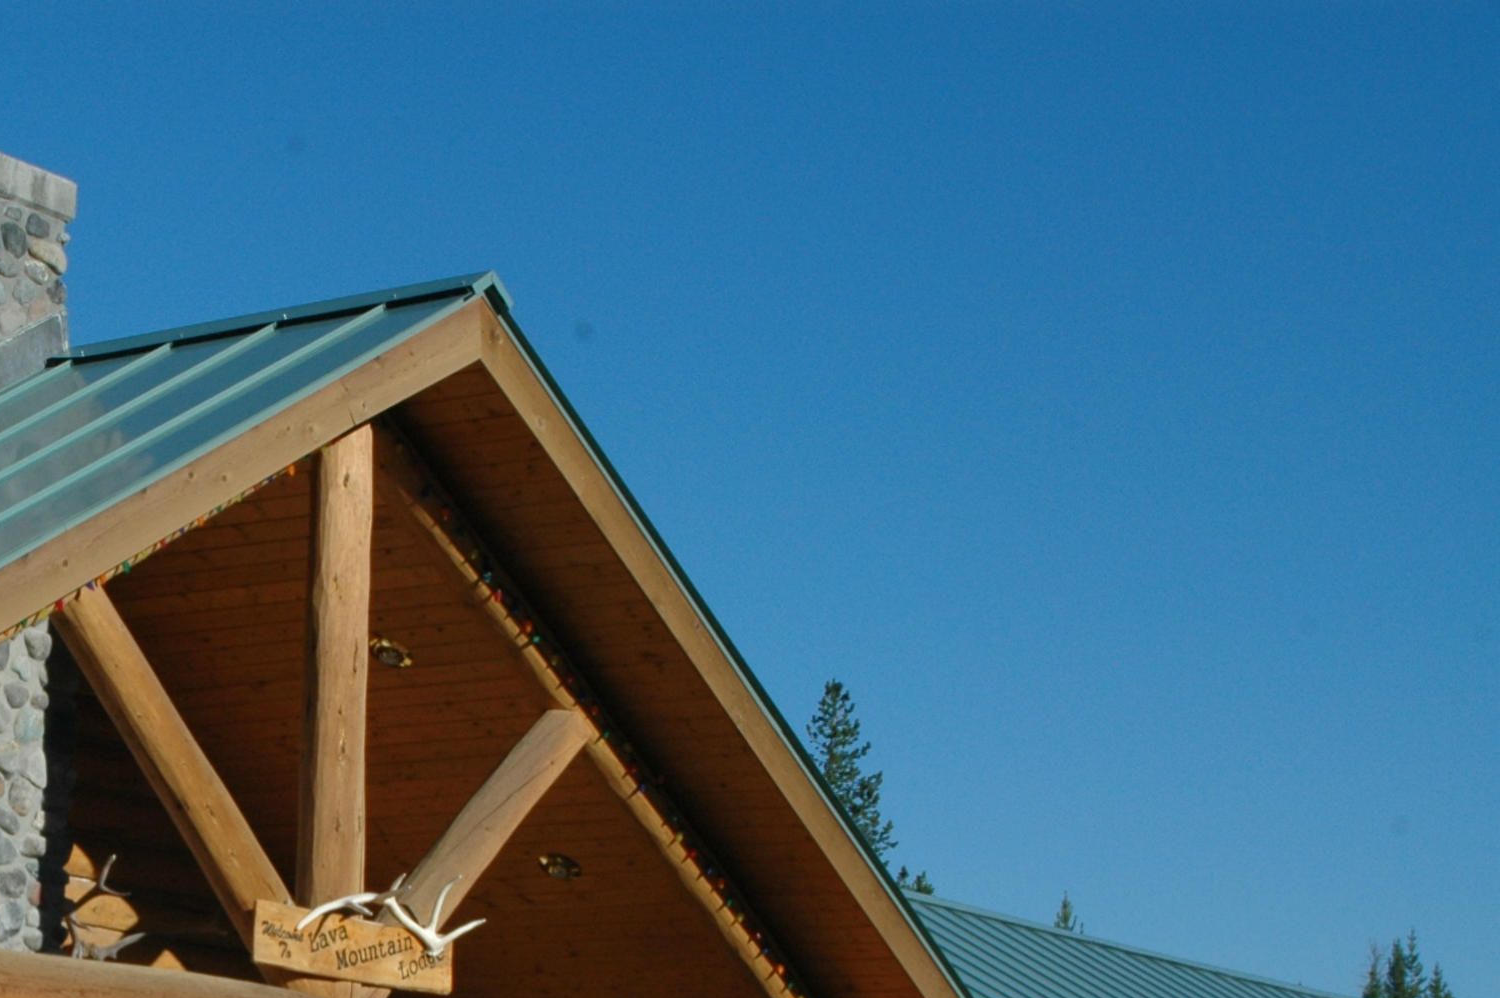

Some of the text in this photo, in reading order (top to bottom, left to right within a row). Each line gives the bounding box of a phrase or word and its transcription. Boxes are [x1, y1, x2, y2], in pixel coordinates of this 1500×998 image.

[308, 924, 349, 953] Lava
[335, 934, 414, 970] Mountain
[398, 950, 445, 980] Lodge
